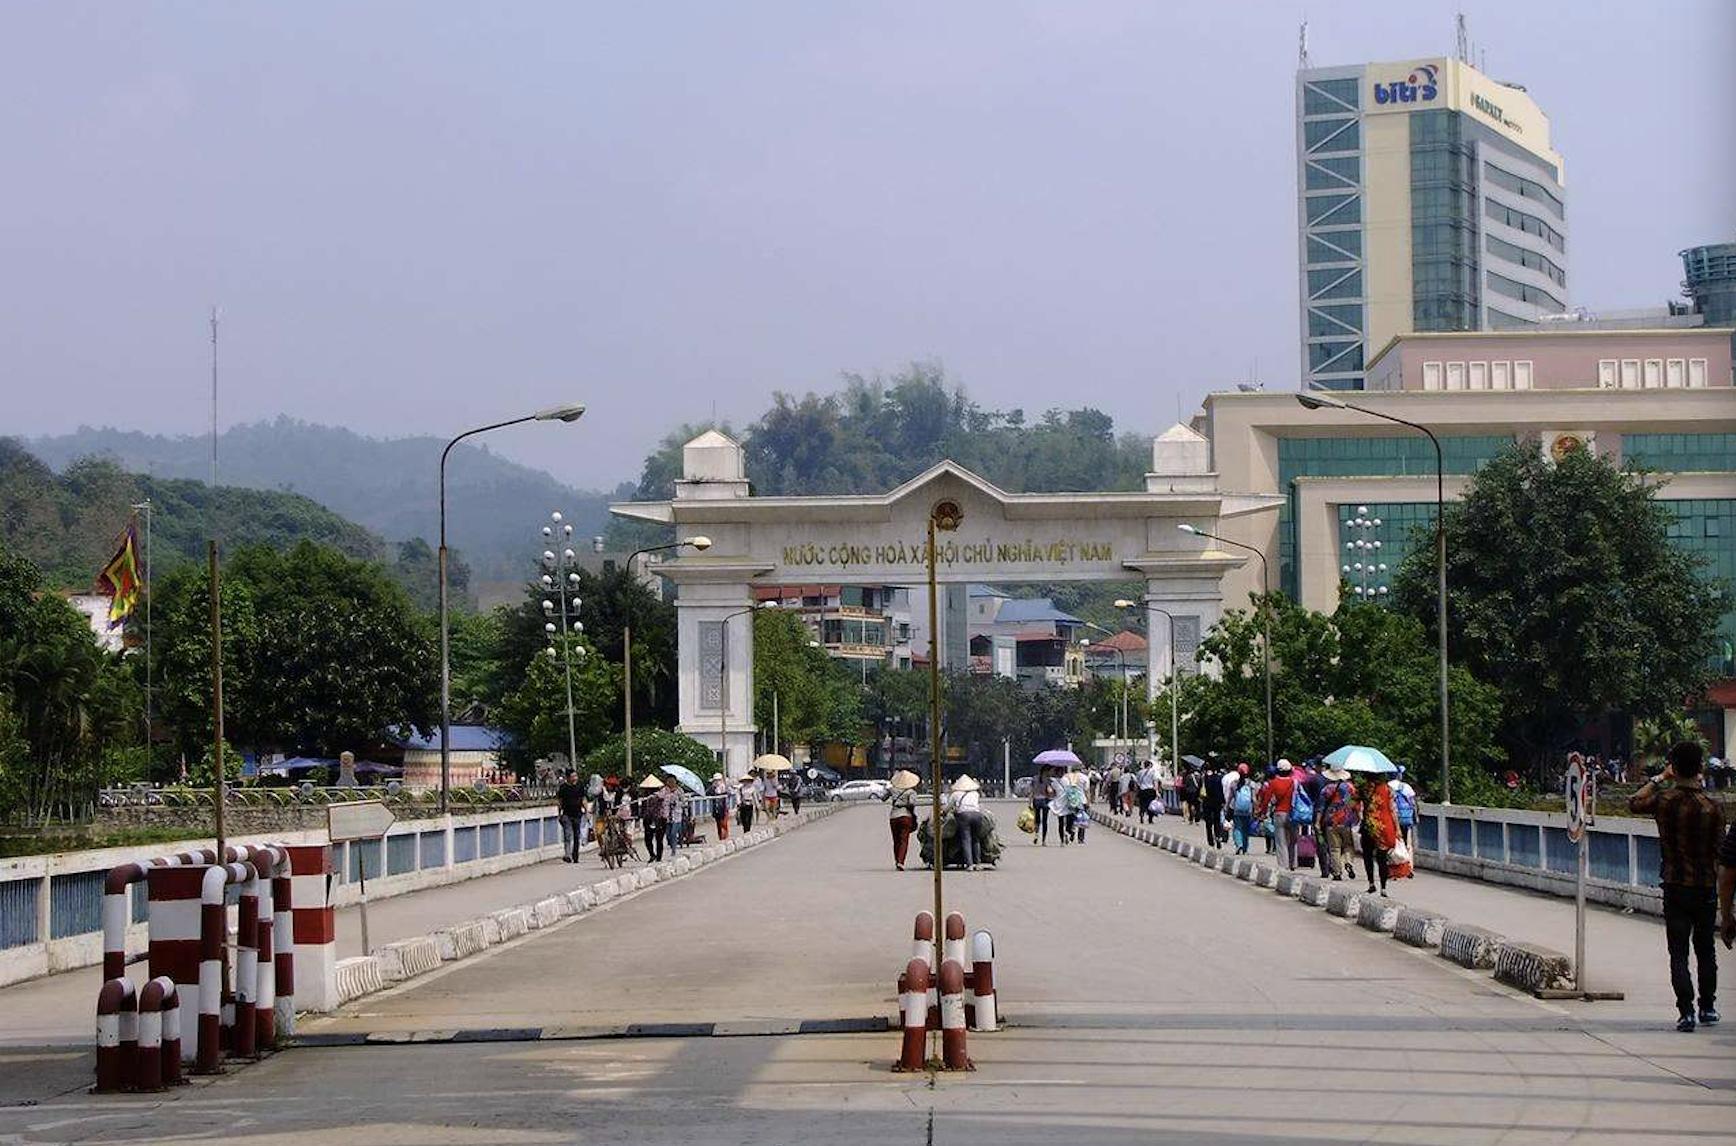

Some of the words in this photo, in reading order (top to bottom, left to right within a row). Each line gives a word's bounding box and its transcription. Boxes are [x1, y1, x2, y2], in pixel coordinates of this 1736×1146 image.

[783, 541, 825, 565] NƯỚC
[829, 542, 871, 569] CỘNG
[875, 540, 907, 564] HOÀ
[935, 540, 959, 568] HỘI
[963, 538, 993, 563] CHỦ
[996, 539, 1044, 563] NGHĨA
[1045, 539, 1076, 565] VIỆT
[1080, 541, 1113, 561] NAM
